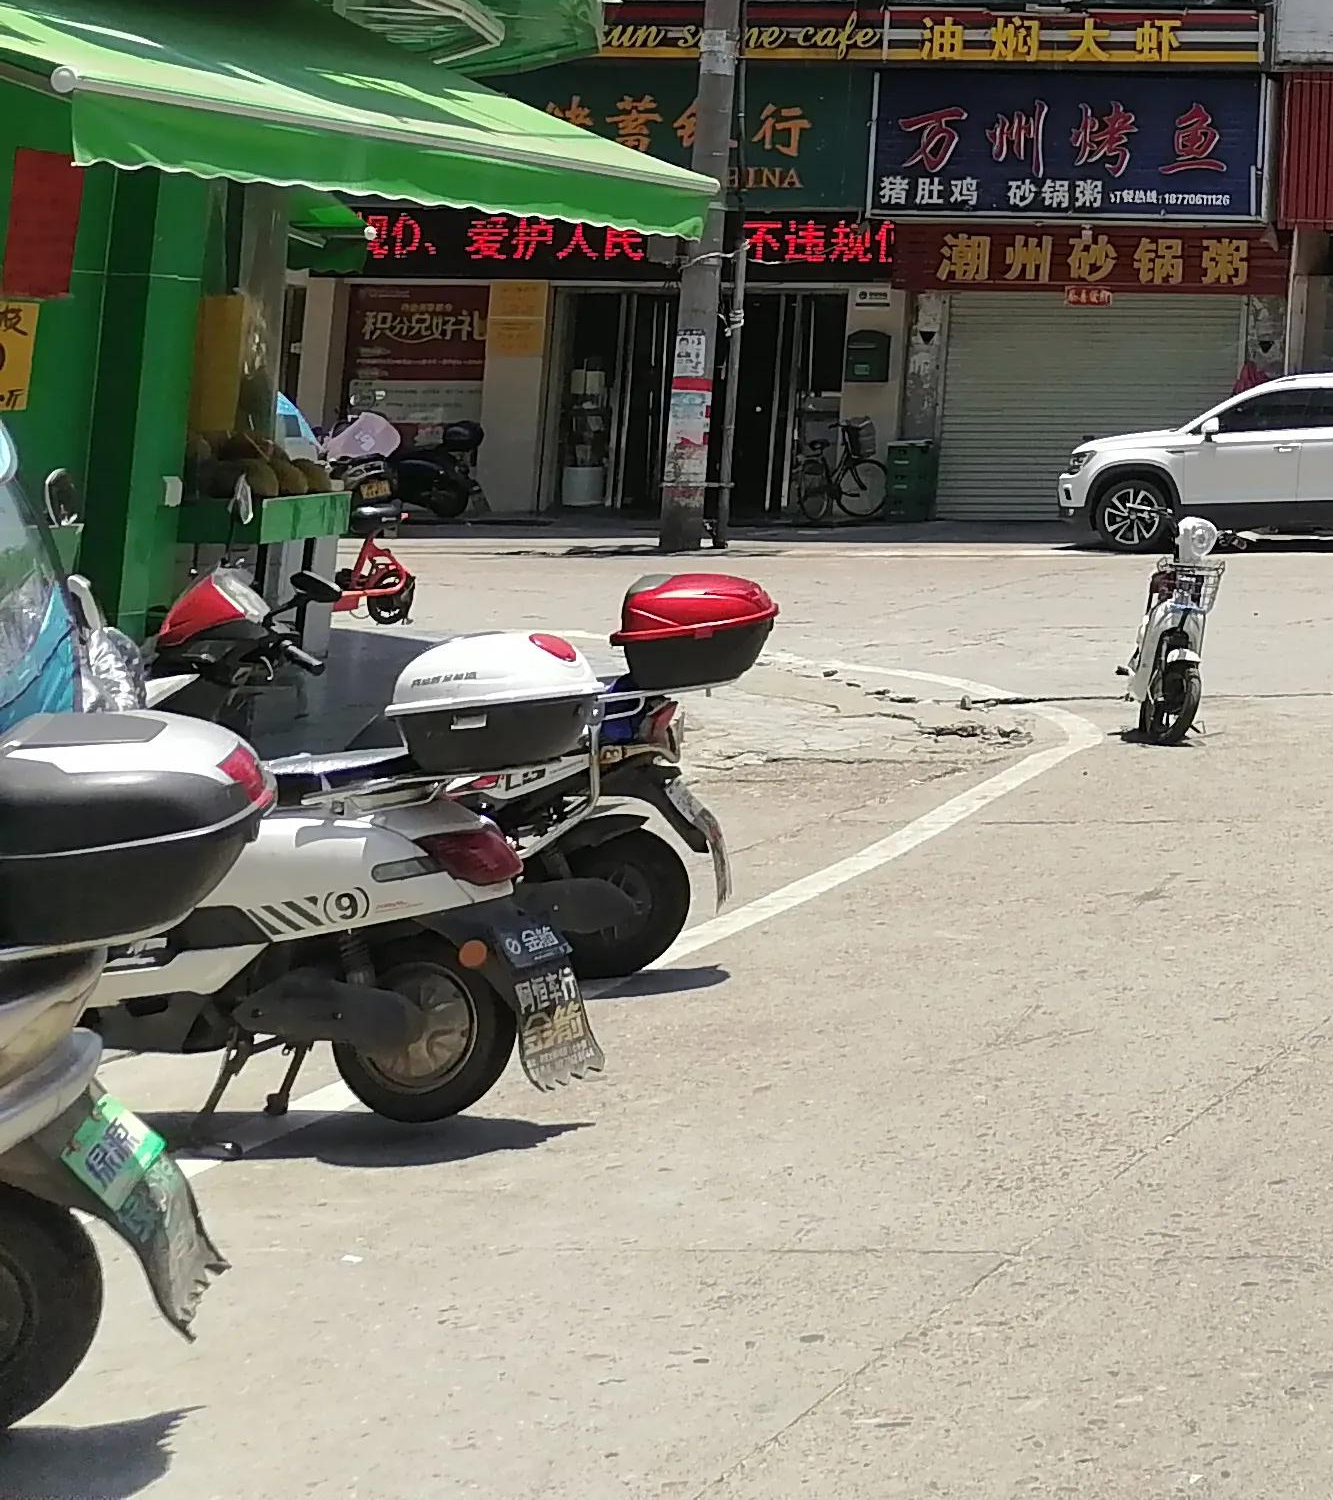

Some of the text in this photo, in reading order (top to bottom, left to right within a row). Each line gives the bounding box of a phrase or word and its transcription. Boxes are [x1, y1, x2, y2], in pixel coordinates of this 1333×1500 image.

[796, 10, 882, 61] cafe
[920, 16, 1182, 62] 油焖大虾
[898, 99, 1227, 178] 万州烤鱼
[879, 176, 979, 206] 猪肚鸡
[1007, 178, 1103, 208] 砂锅粥
[936, 232, 1250, 285] 潮州砂锅粥
[362, 309, 489, 342] 积分兑好礼
